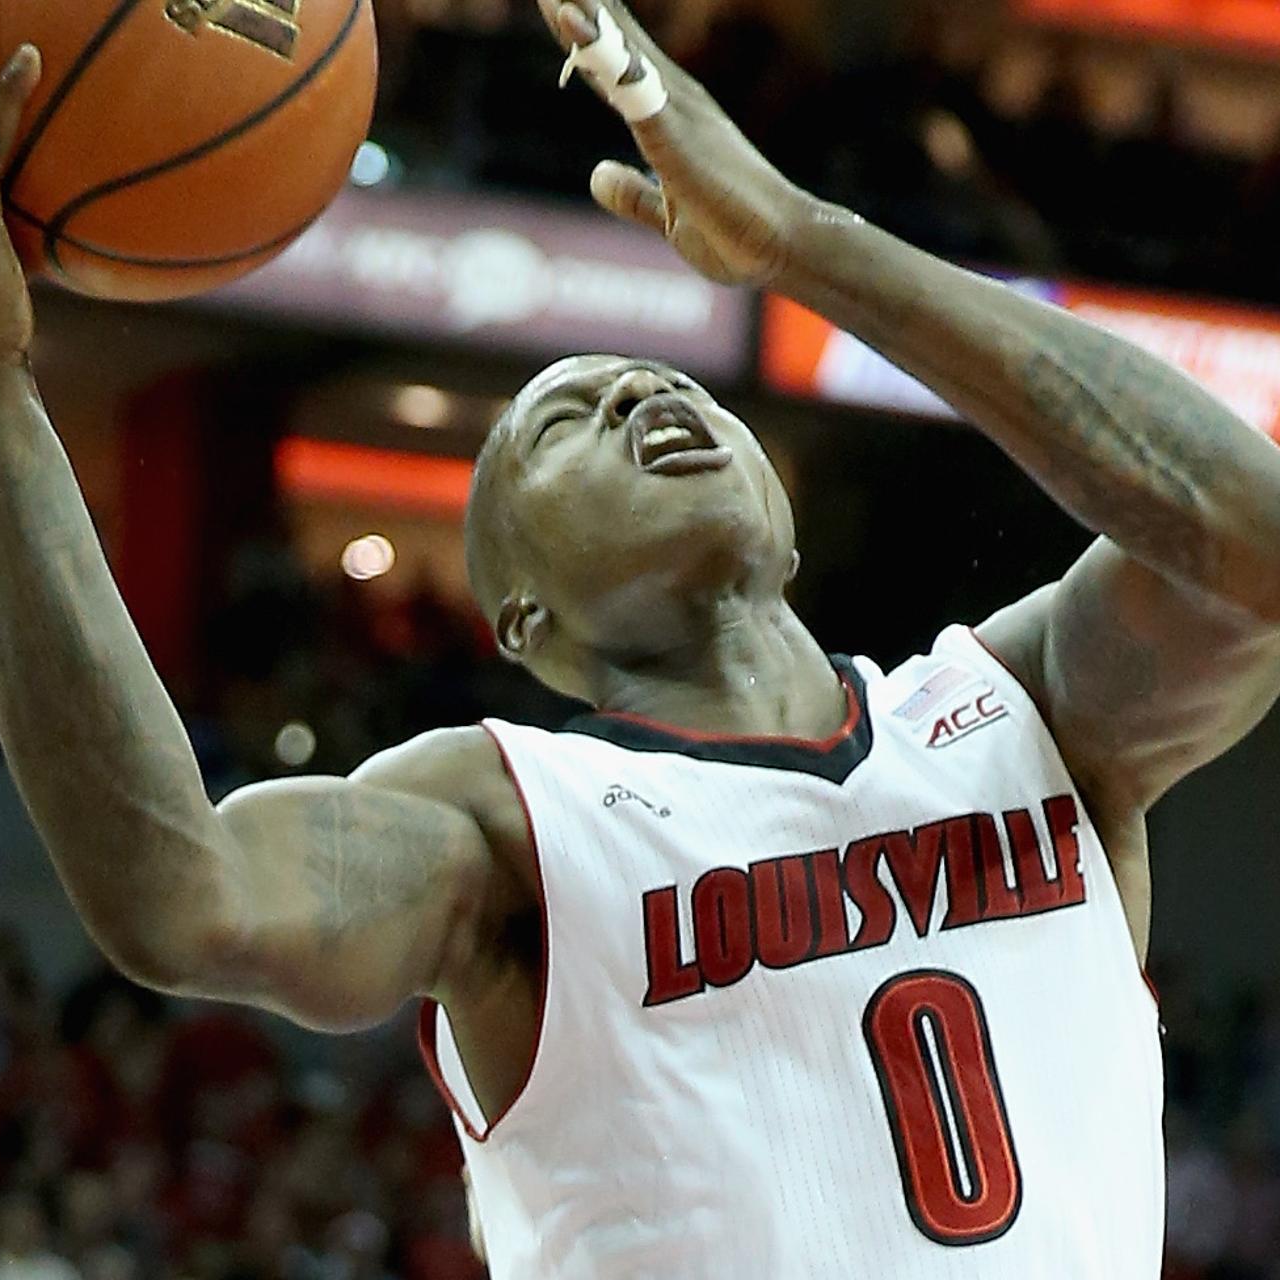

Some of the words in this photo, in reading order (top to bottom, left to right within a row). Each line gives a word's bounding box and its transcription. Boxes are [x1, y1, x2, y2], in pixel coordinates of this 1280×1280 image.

[925, 686, 1008, 749] ACC
[642, 793, 1087, 1007] LOUISVILLE
[862, 969, 1023, 1247] 0
